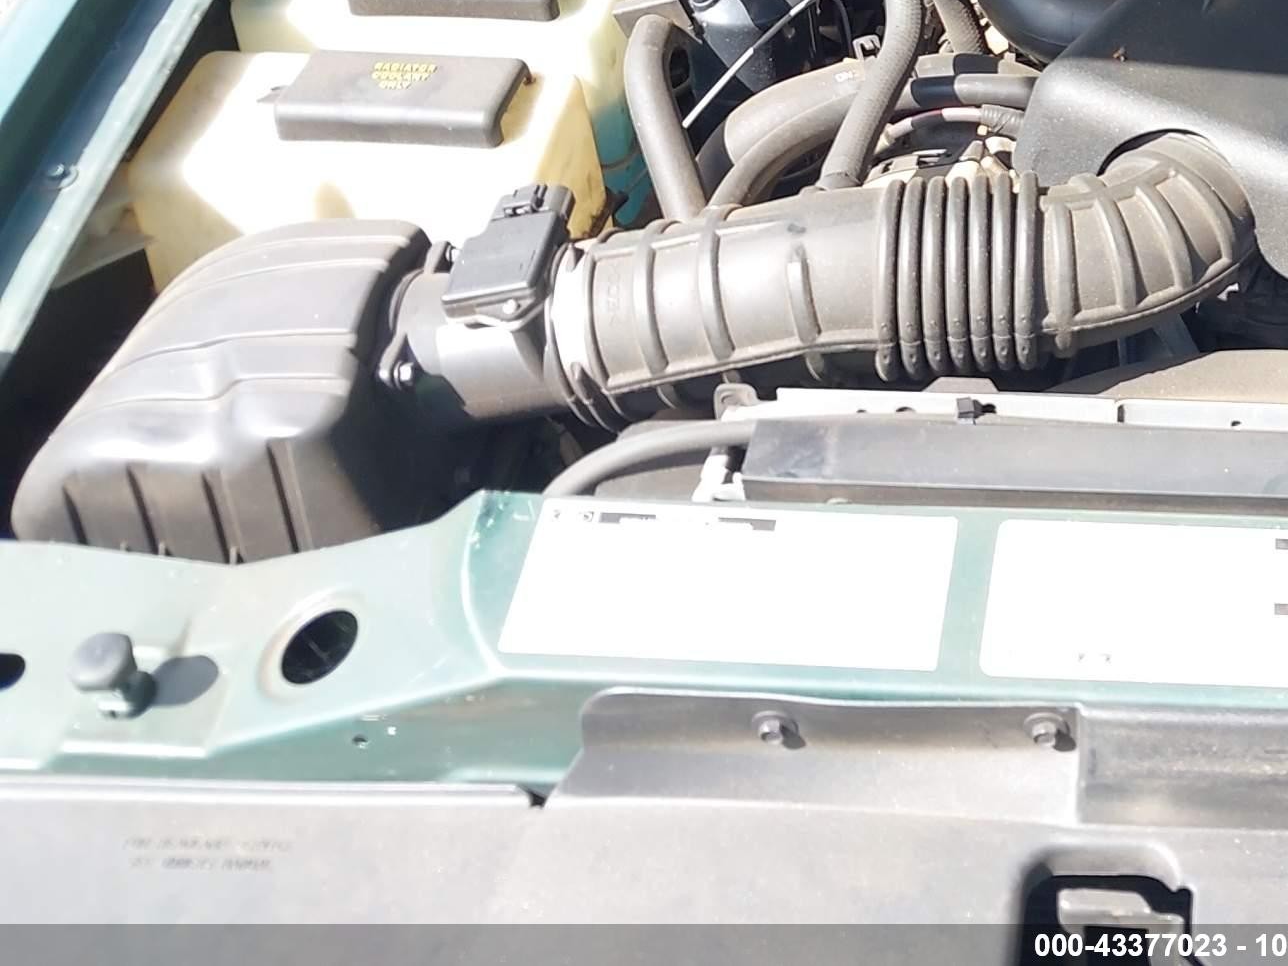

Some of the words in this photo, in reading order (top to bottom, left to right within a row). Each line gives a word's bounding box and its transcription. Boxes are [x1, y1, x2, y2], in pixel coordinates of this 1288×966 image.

[374, 61, 438, 74] RADIATOR
[371, 71, 431, 82] COOLANT
[378, 80, 412, 90] ONLY
